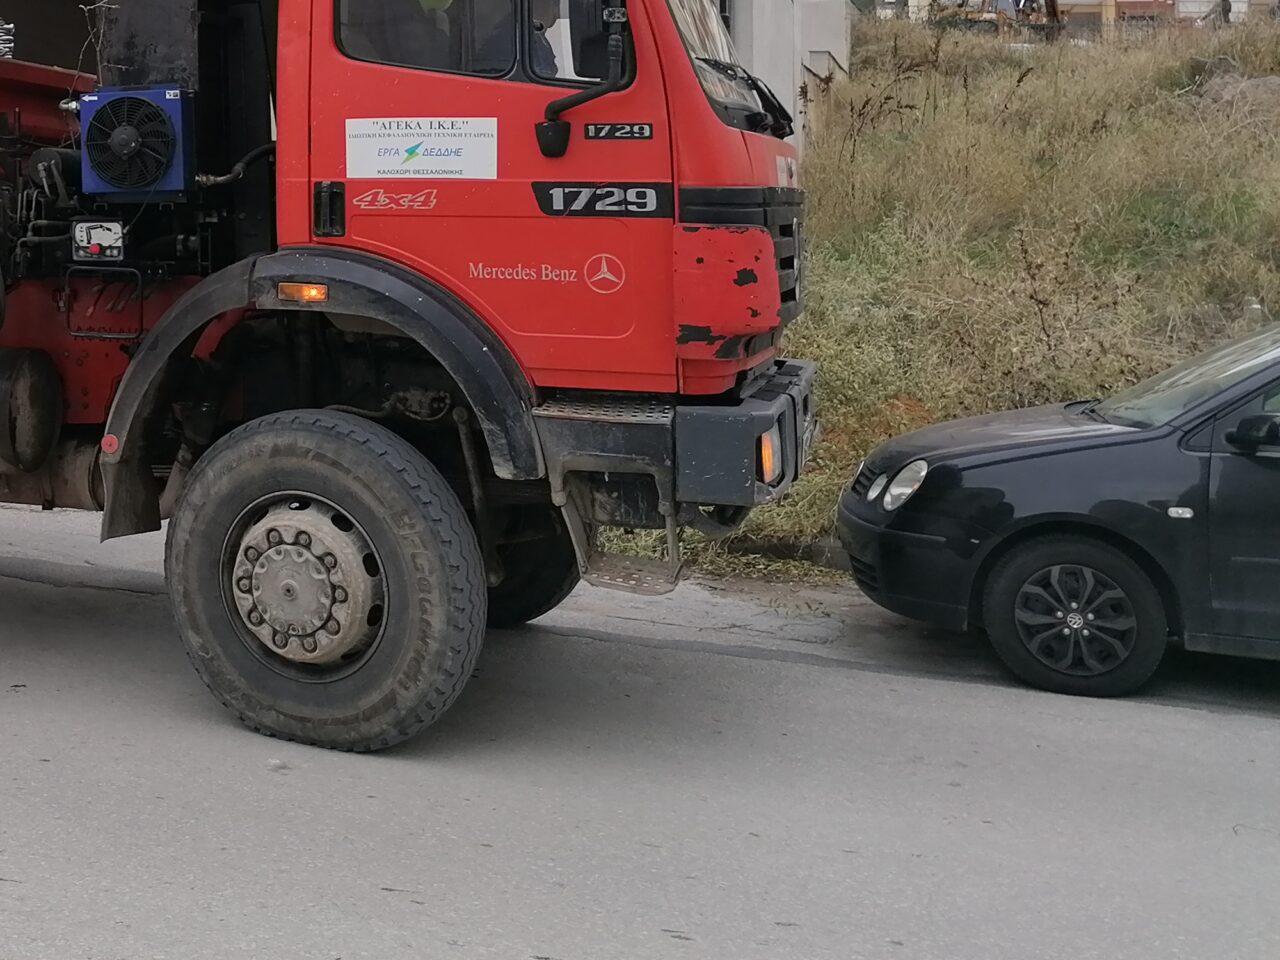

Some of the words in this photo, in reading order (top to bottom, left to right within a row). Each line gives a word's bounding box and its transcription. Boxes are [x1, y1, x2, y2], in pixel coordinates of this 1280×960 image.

[587, 124, 651, 137] 1729
[377, 147, 400, 157] ΕΡΓΑ
[422, 147, 463, 157] ΔΕΔΔΗΕ
[548, 187, 658, 212] 1729
[468, 262, 537, 280] Mercedes
[541, 264, 577, 283] Benz
